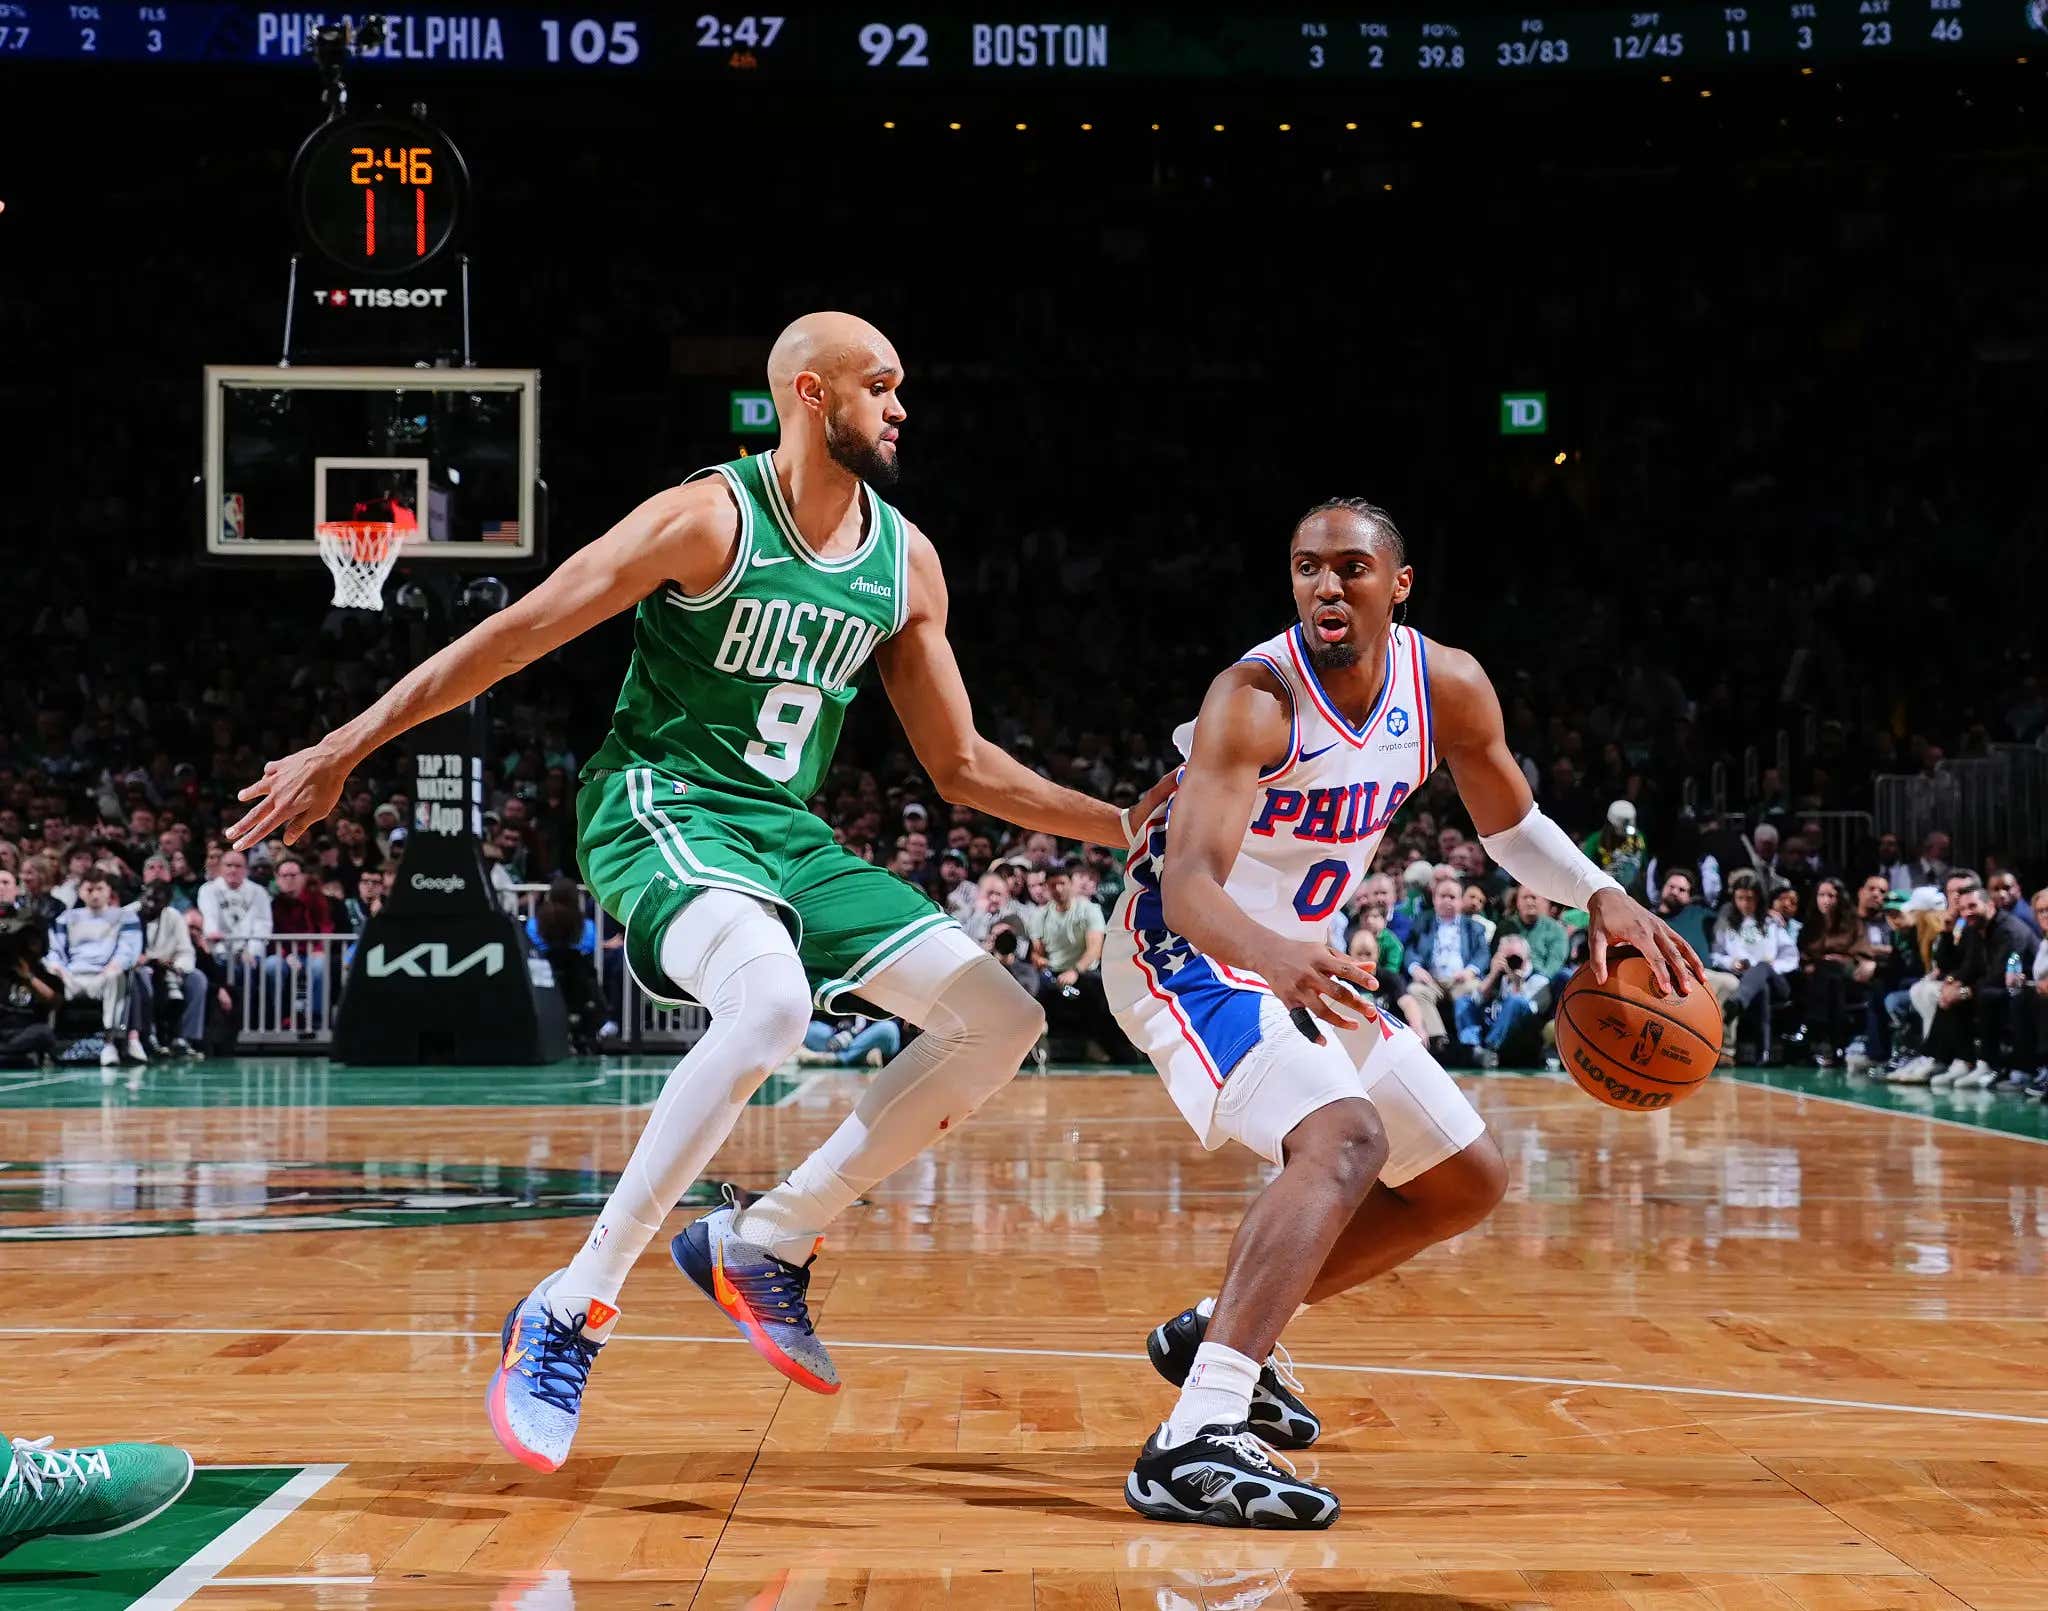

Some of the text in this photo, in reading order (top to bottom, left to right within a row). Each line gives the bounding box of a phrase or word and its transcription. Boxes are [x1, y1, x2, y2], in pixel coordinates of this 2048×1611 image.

[69, 4, 101, 20] TOL
[139, 6, 167, 21] FLS
[80, 27, 96, 52] 2
[146, 29, 163, 53] 3
[541, 18, 640, 65] 105
[695, 14, 786, 48] 2:47
[1726, 29, 1751, 54] 11
[1796, 25, 1814, 50] 3
[1860, 21, 1893, 47] 23
[1930, 17, 1964, 42] 46
[857, 22, 930, 67] 92
[972, 22, 1109, 67] BOSTON
[1308, 45, 1325, 69] 3
[1368, 45, 1385, 69] 2
[1417, 45, 1466, 69] 39.8
[1496, 39, 1570, 67] 33/83
[1612, 32, 1685, 60] 12/45
[350, 147, 433, 185] 2:46
[365, 187, 426, 257] 11
[349, 288, 449, 308] TISSOT
[734, 397, 775, 426] TD
[1503, 398, 1543, 428] TD
[850, 575, 892, 598] Amica
[713, 598, 887, 692] BOSTON
[743, 681, 823, 783] 9
[1378, 740, 1420, 753] crypto.com
[416, 754, 463, 777] TAP TO
[430, 802, 464, 838] App
[1250, 781, 1410, 845] PHILA
[410, 873, 465, 894] Google
[1292, 858, 1351, 922] 0
[366, 942, 505, 978] KIA
